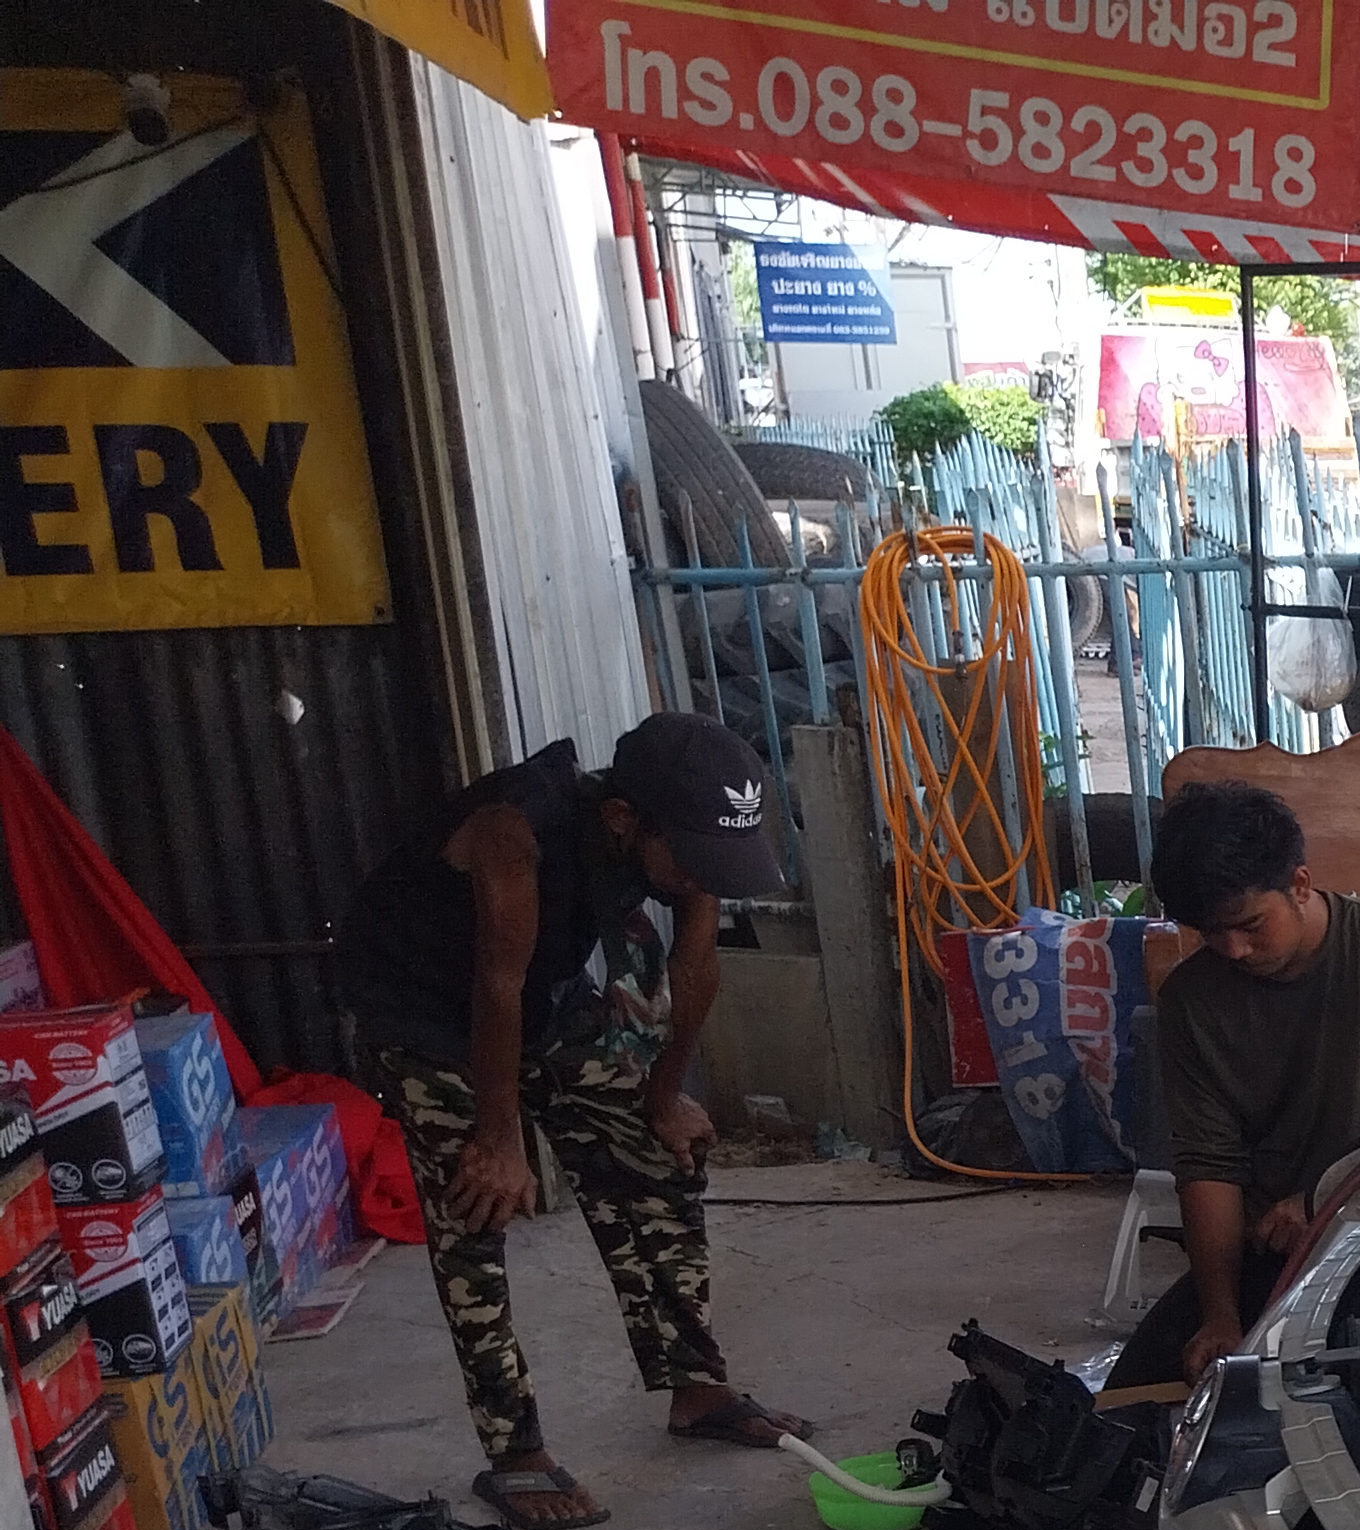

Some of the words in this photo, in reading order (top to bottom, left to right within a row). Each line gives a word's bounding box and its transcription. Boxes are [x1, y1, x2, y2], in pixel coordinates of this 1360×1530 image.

[719, 812, 763, 828] adidas
[234, 1191, 256, 1226] UASA
[41, 1282, 78, 1331] YUASA
[77, 1444, 116, 1498] YUASA
